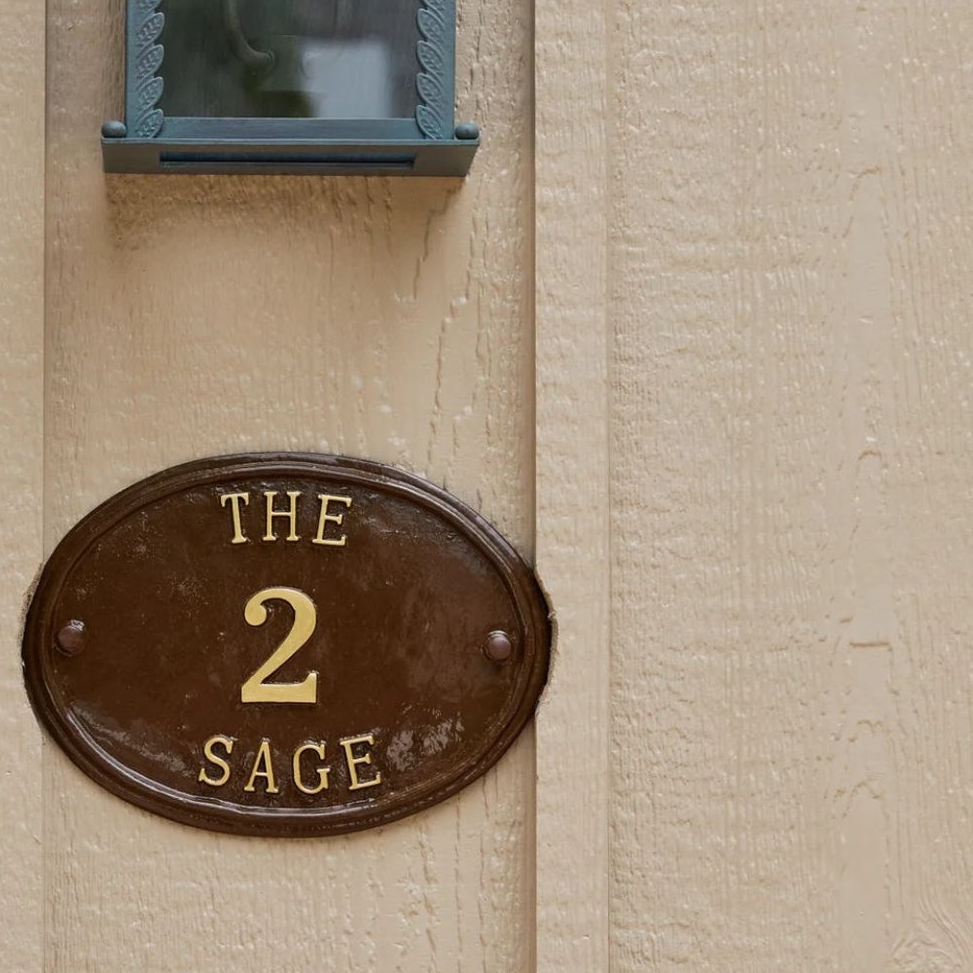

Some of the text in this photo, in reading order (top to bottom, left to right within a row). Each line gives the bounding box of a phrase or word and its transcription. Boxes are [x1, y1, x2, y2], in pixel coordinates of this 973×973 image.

[220, 491, 353, 547] THE
[241, 587, 318, 704] 2
[198, 734, 383, 795] SAGE
